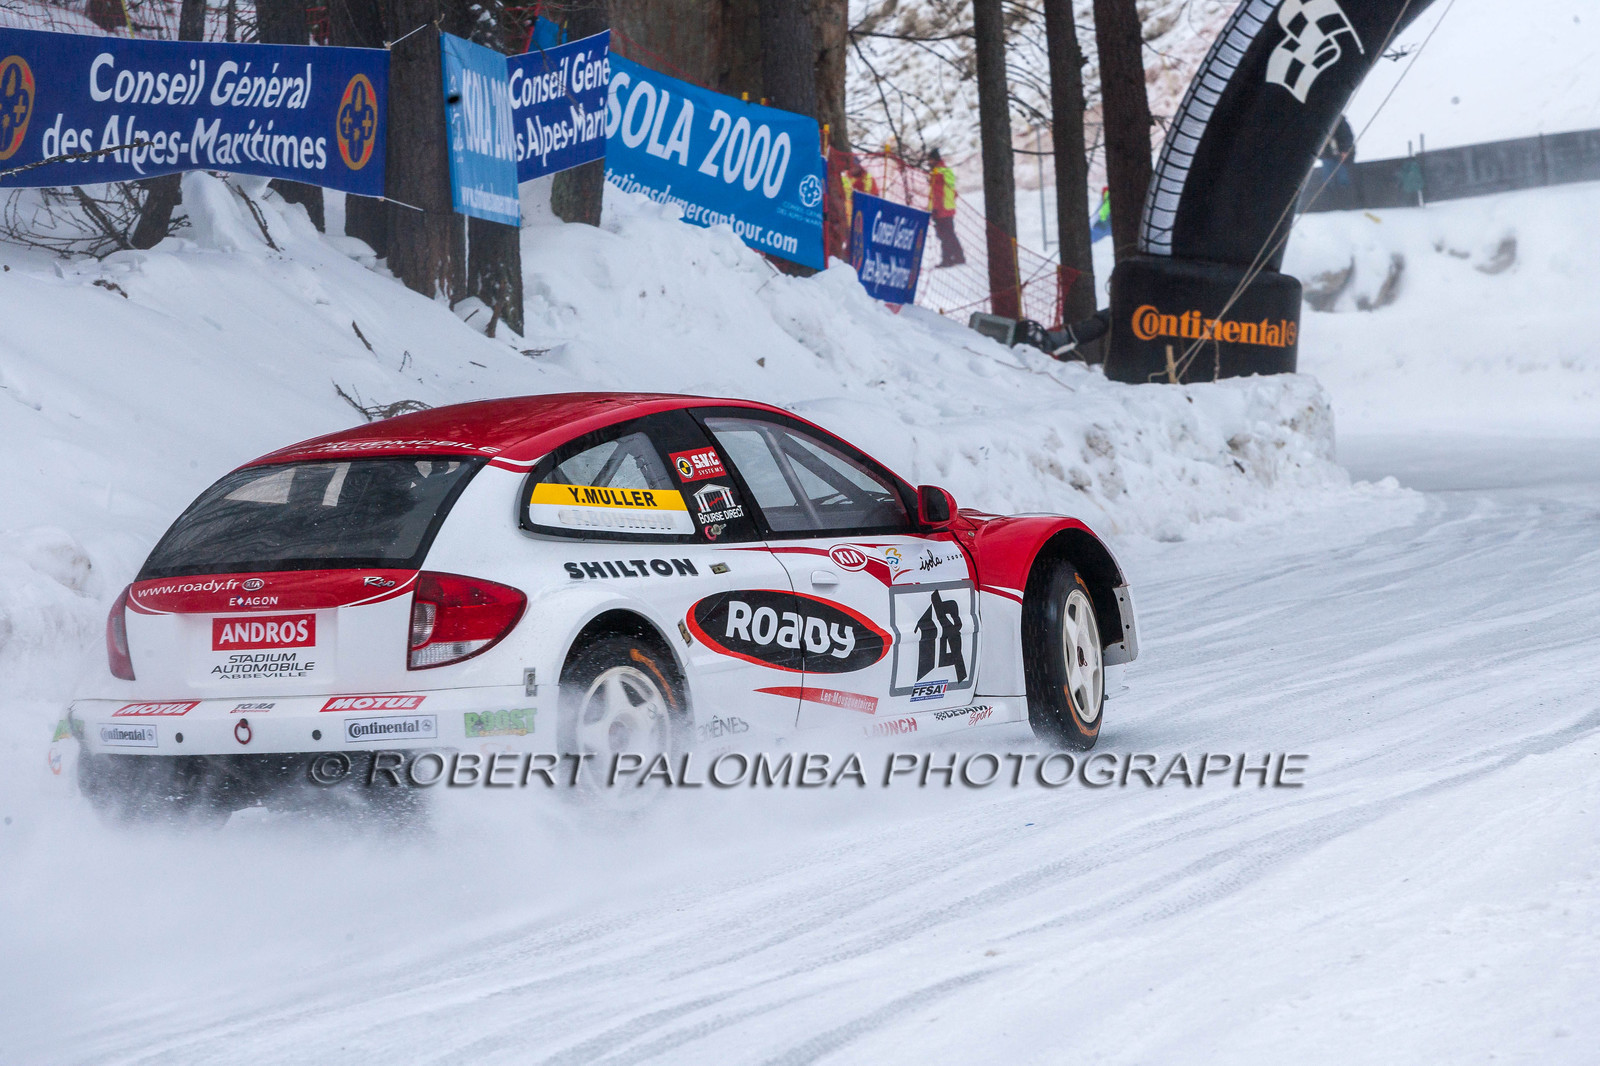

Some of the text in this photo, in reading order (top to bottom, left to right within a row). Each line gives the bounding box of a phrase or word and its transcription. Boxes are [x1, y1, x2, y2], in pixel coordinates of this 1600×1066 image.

[89, 52, 312, 109] Conseil Général
[509, 45, 611, 110] Conseil Géné
[42, 113, 326, 175] des Alpes-Maritimes
[606, 71, 791, 199] SOLA 2000
[604, 166, 798, 254] tationsdumercantour.com
[1131, 304, 1287, 348] Continental
[697, 466, 724, 476] SYSTEMS
[567, 486, 658, 508] Y.MULLER
[697, 504, 745, 525] BOURSE DIRECT
[563, 558, 699, 580] SHILTON
[833, 551, 864, 566] KIA
[137, 578, 240, 599] www.roady.fr
[362, 575, 396, 588] Rio
[218, 619, 309, 645] ANDROS
[914, 589, 967, 683] 18
[211, 661, 316, 674] AUTOMOBILE
[228, 652, 297, 664] STADIUM
[219, 671, 307, 680] ABBEVILLE
[911, 684, 942, 697] FFSA
[120, 702, 194, 716] MOTUL
[325, 697, 420, 710] MOTUL
[348, 719, 420, 738] Continental
